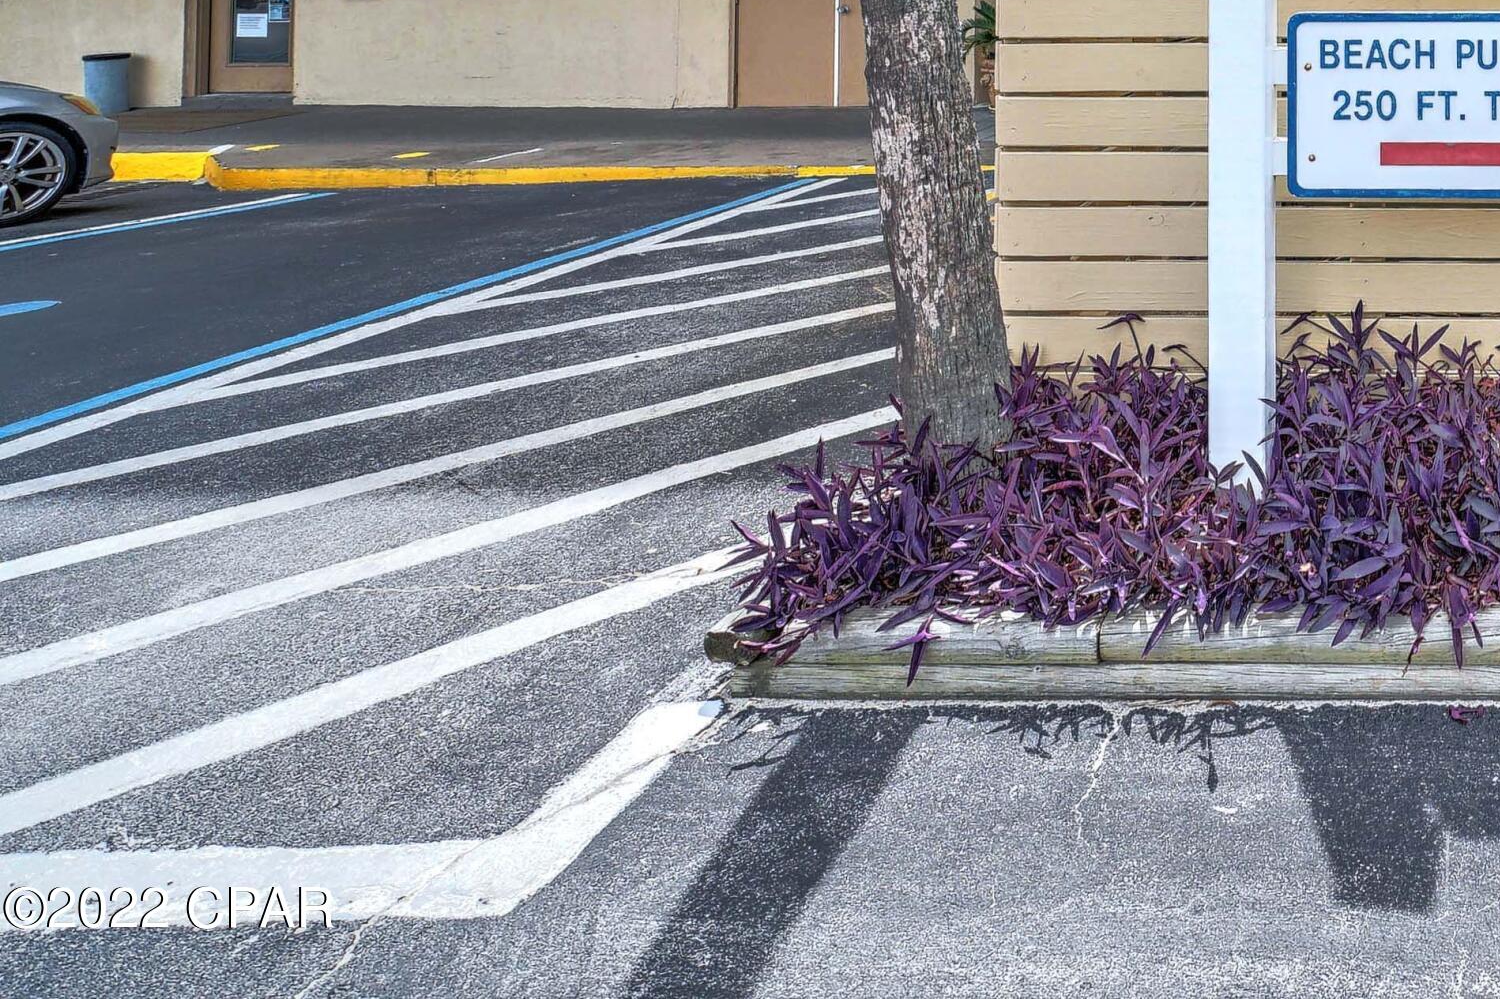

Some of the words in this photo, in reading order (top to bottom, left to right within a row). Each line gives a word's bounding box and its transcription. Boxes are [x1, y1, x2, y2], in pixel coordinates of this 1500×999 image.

[1320, 39, 1435, 70] BEACH
[1333, 90, 1397, 121] 250
[1417, 91, 1465, 121] FT.
